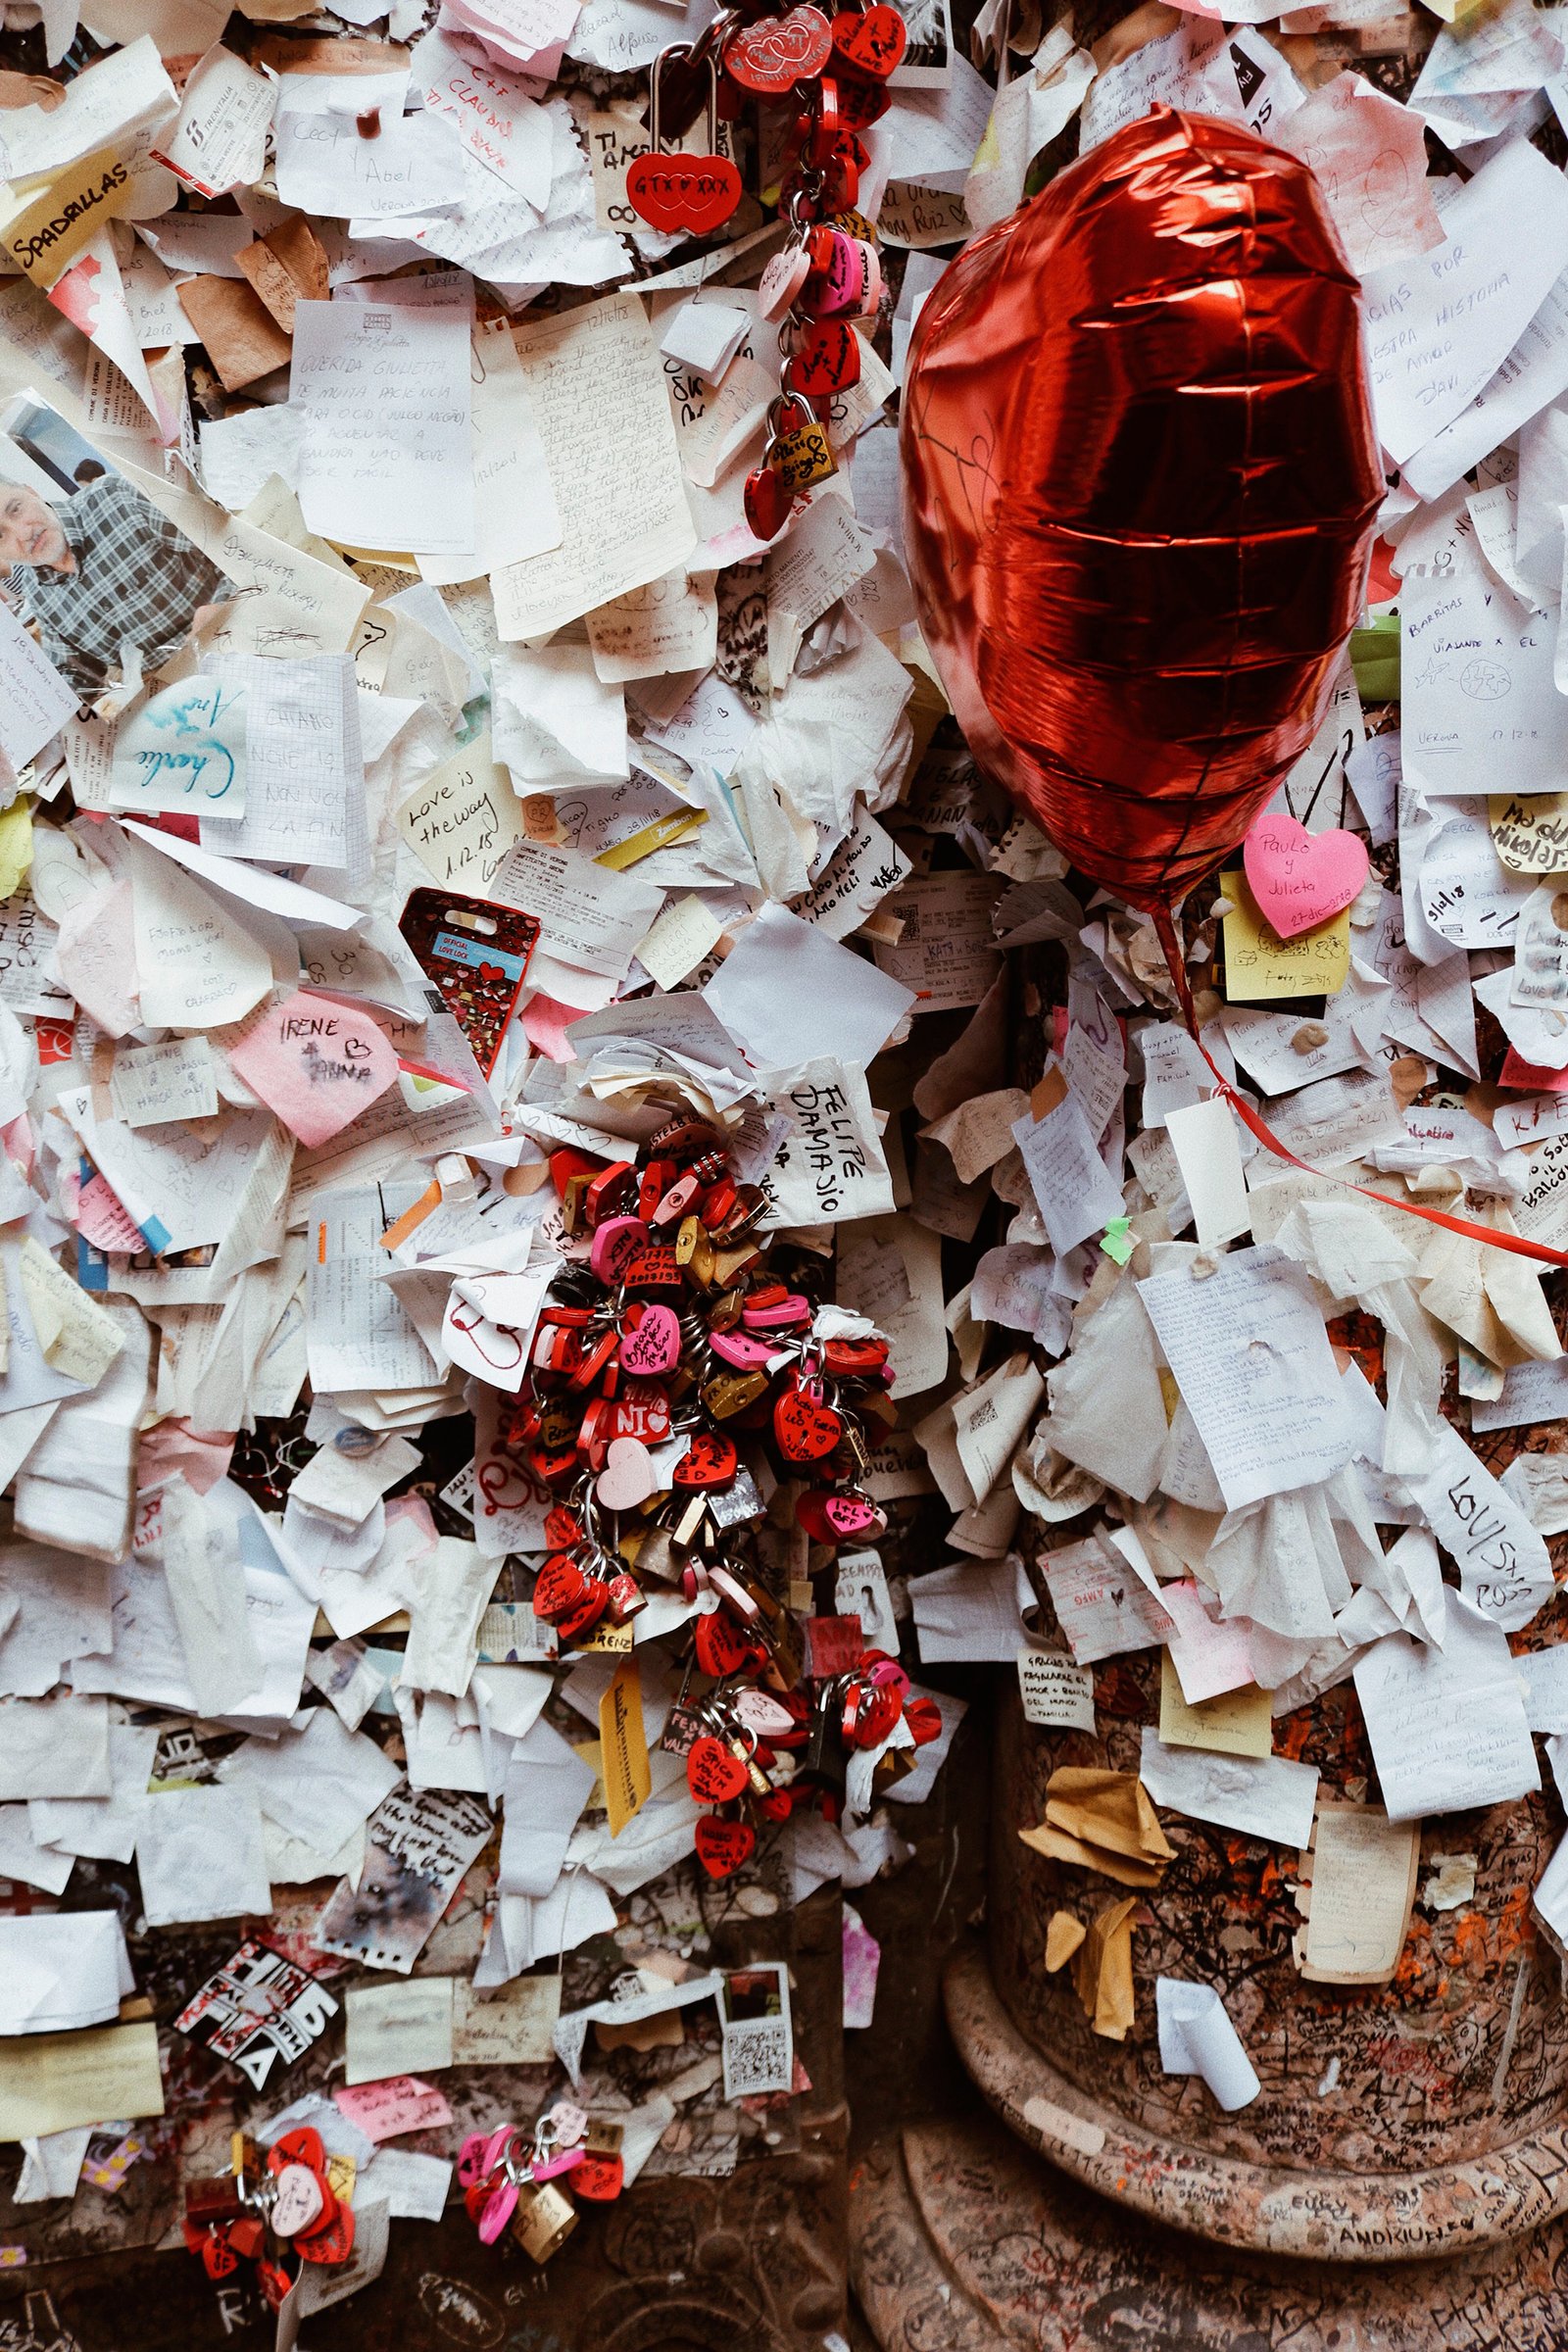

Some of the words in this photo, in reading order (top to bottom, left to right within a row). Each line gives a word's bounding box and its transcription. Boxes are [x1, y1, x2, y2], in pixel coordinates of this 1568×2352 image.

[204, 85, 234, 132] TRENITALIA
[366, 159, 413, 184] Abel
[12, 162, 130, 271] SPADRILLAS
[134, 738, 235, 800] Charlie
[655, 813, 693, 840] Zambon
[550, 854, 568, 867] VERONA
[1268, 883, 1316, 897] Julieta
[1428, 885, 1465, 922] 9/12/18
[438, 946, 454, 956] LOVE
[453, 950, 469, 959] LOCK
[443, 937, 468, 950] OFFICIAL
[280, 1017, 340, 1042] IRENE
[819, 1084, 866, 1179] FELIPE
[832, 1510, 857, 1526] BFF
